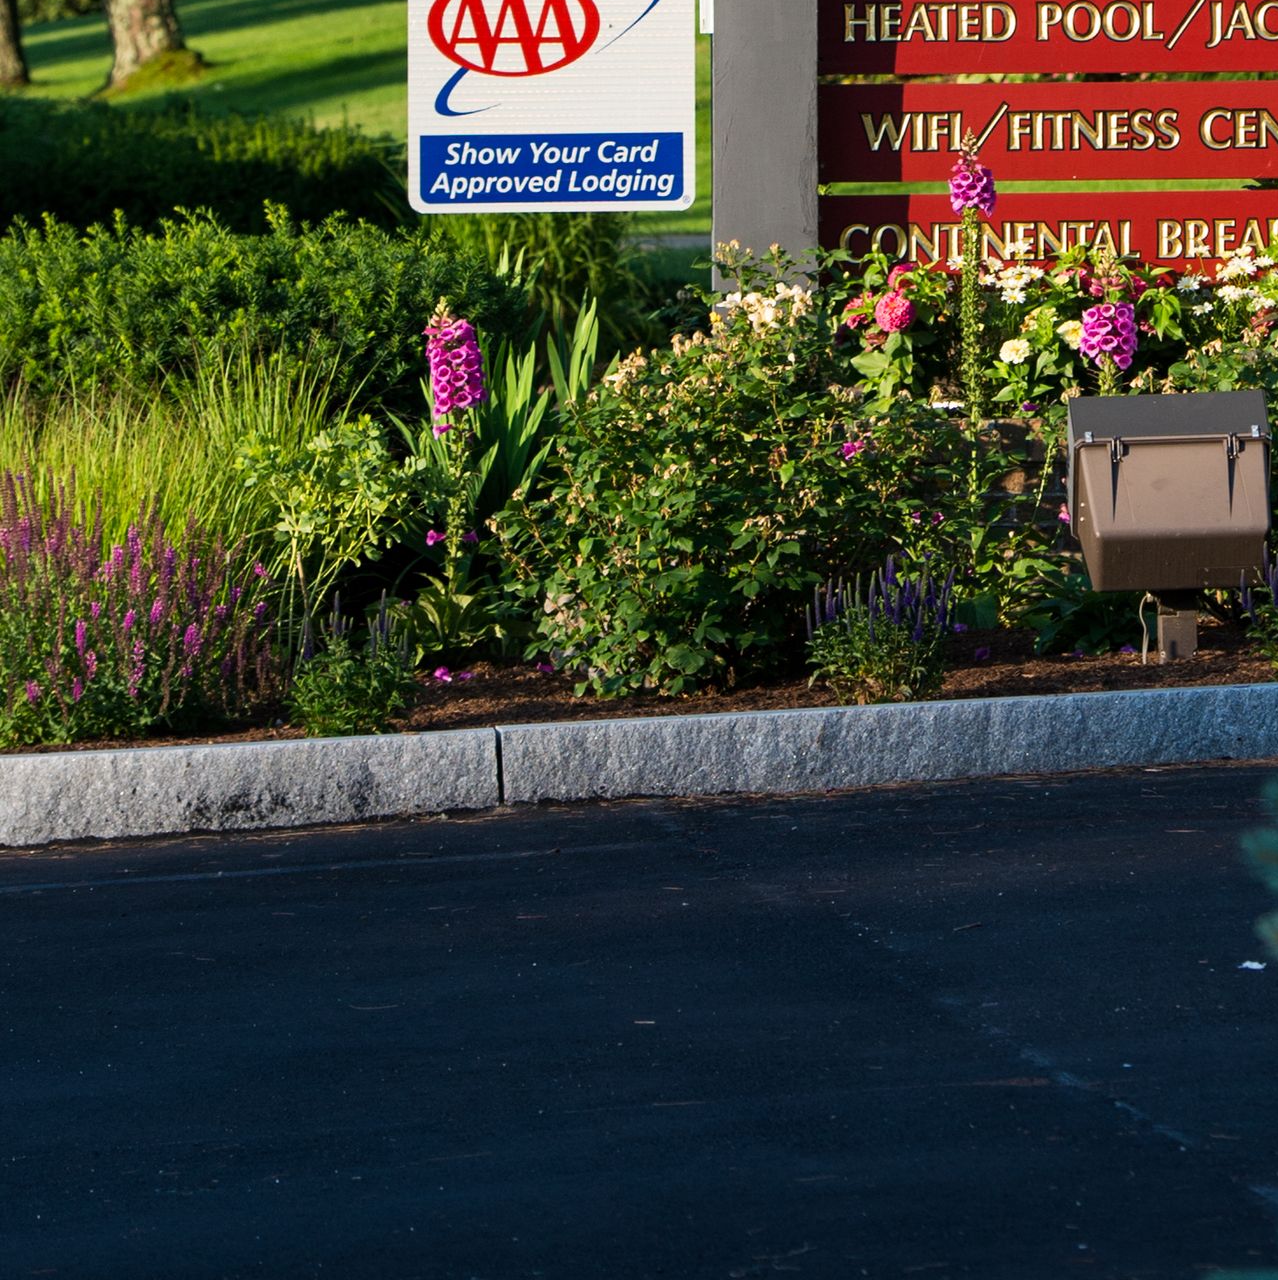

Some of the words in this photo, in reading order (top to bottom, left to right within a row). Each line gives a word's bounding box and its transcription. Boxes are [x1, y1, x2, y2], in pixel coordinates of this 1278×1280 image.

[843, 1, 1017, 43] HEATED
[445, 142, 520, 165] Show
[530, 142, 590, 164] Your
[597, 139, 659, 163] Card
[430, 171, 561, 199] Approved
[568, 169, 675, 198] Lodging
[839, 220, 1140, 264] CONTNENTAL
